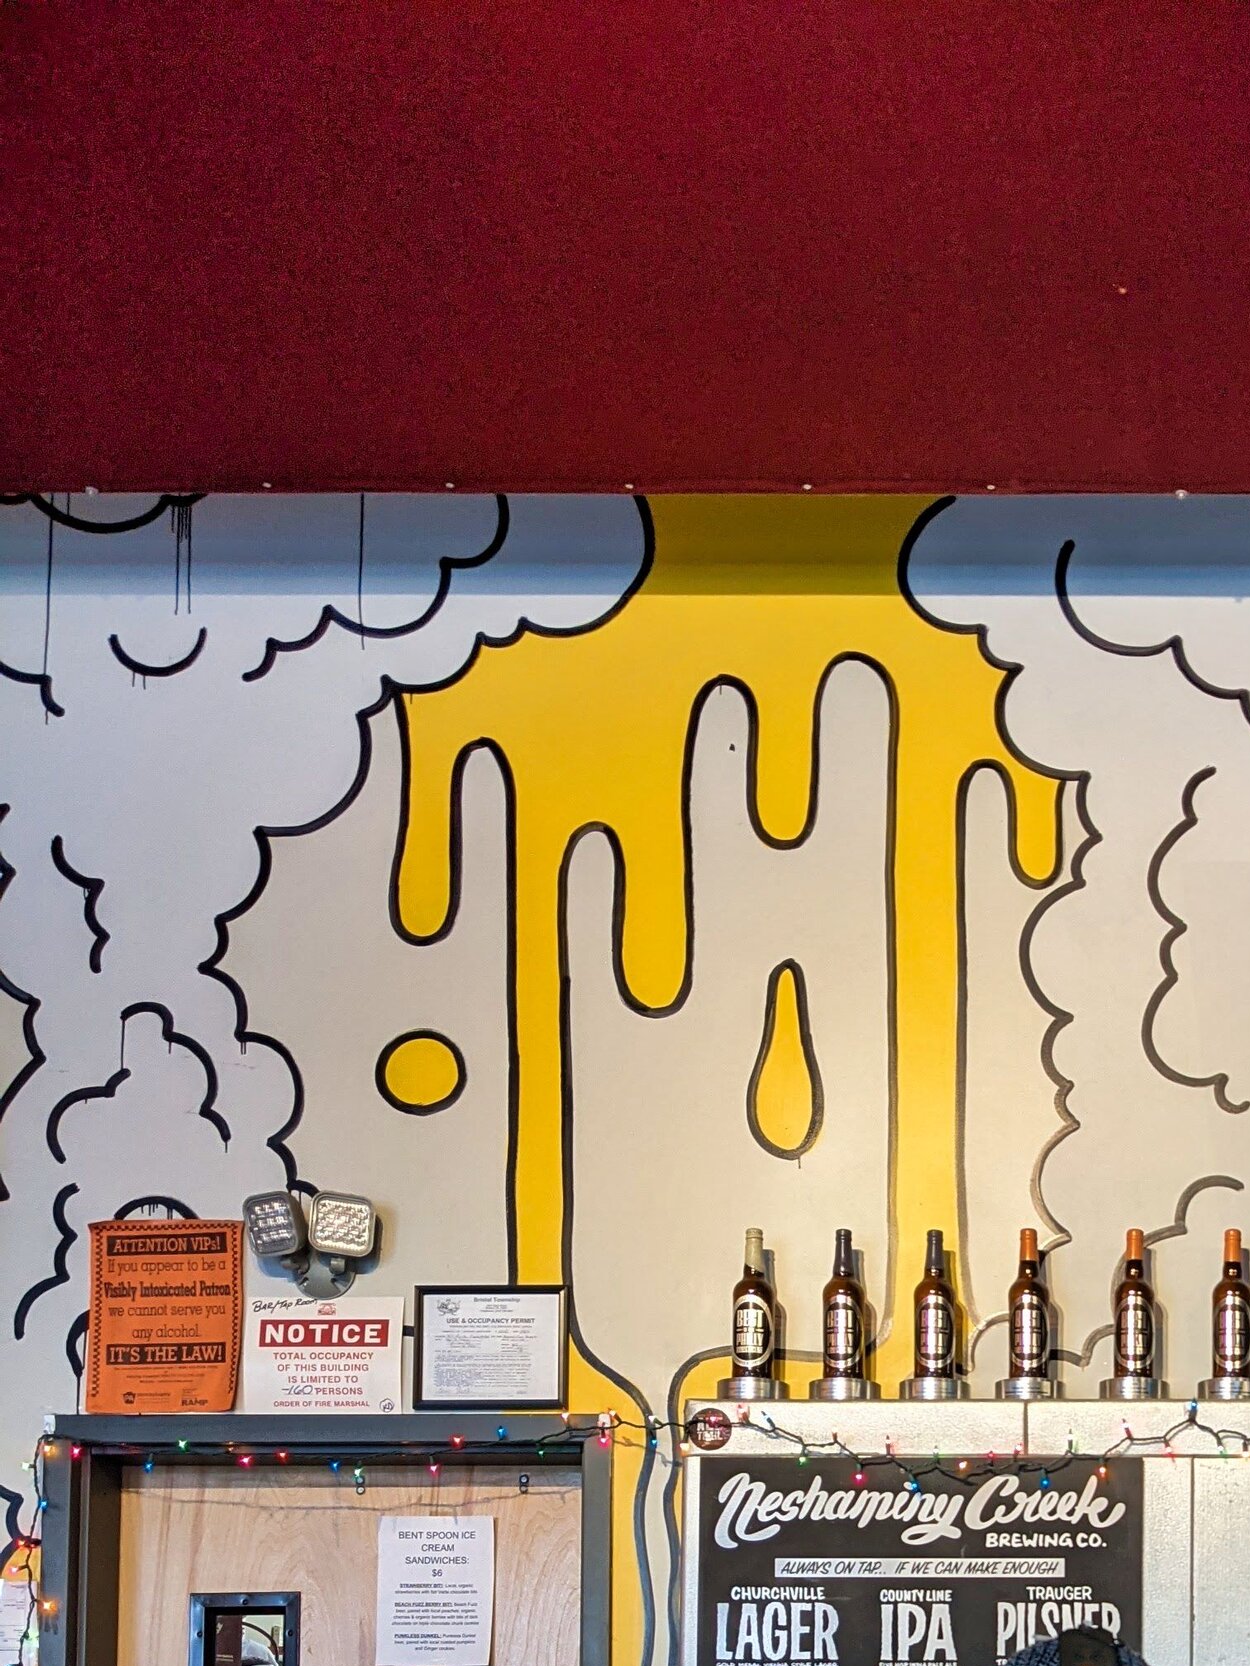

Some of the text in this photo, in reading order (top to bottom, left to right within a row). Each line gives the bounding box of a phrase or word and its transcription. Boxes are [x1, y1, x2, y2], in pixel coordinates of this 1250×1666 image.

[113, 1237, 188, 1253] ATTENTION
[118, 1259, 226, 1276] you appear to be a
[104, 1281, 230, 1300] Visibly Intoxicated Patron
[108, 1305, 226, 1318] we cannot serve you
[132, 1327, 153, 1341] any
[265, 1324, 382, 1343] NOTICE
[109, 1346, 222, 1363] IT'S THE LAW!
[273, 1352, 374, 1360] TOTAL OCCUPANCY
[277, 1364, 369, 1372] OF THIS BUILDING
[333, 1400, 370, 1408] MARSHAL
[714, 1473, 1127, 1548] Neshaminy Creek
[398, 1531, 476, 1540] BENT SPOON ICE
[985, 1532, 1107, 1548] BREWING CO.
[421, 1543, 455, 1552] CREAM
[405, 1556, 470, 1565] SANDWICHES:
[781, 1560, 1058, 1575] ALWAYS ON IF WE CAN MAKE ENOUGH
[431, 1568, 443, 1578] $6
[731, 1586, 826, 1601] CHURCHVILLE
[879, 1589, 953, 1602] COUNTY LINE
[1026, 1586, 1092, 1600] TRAUGER
[715, 1601, 840, 1661] LAGER
[880, 1603, 958, 1661] IPA
